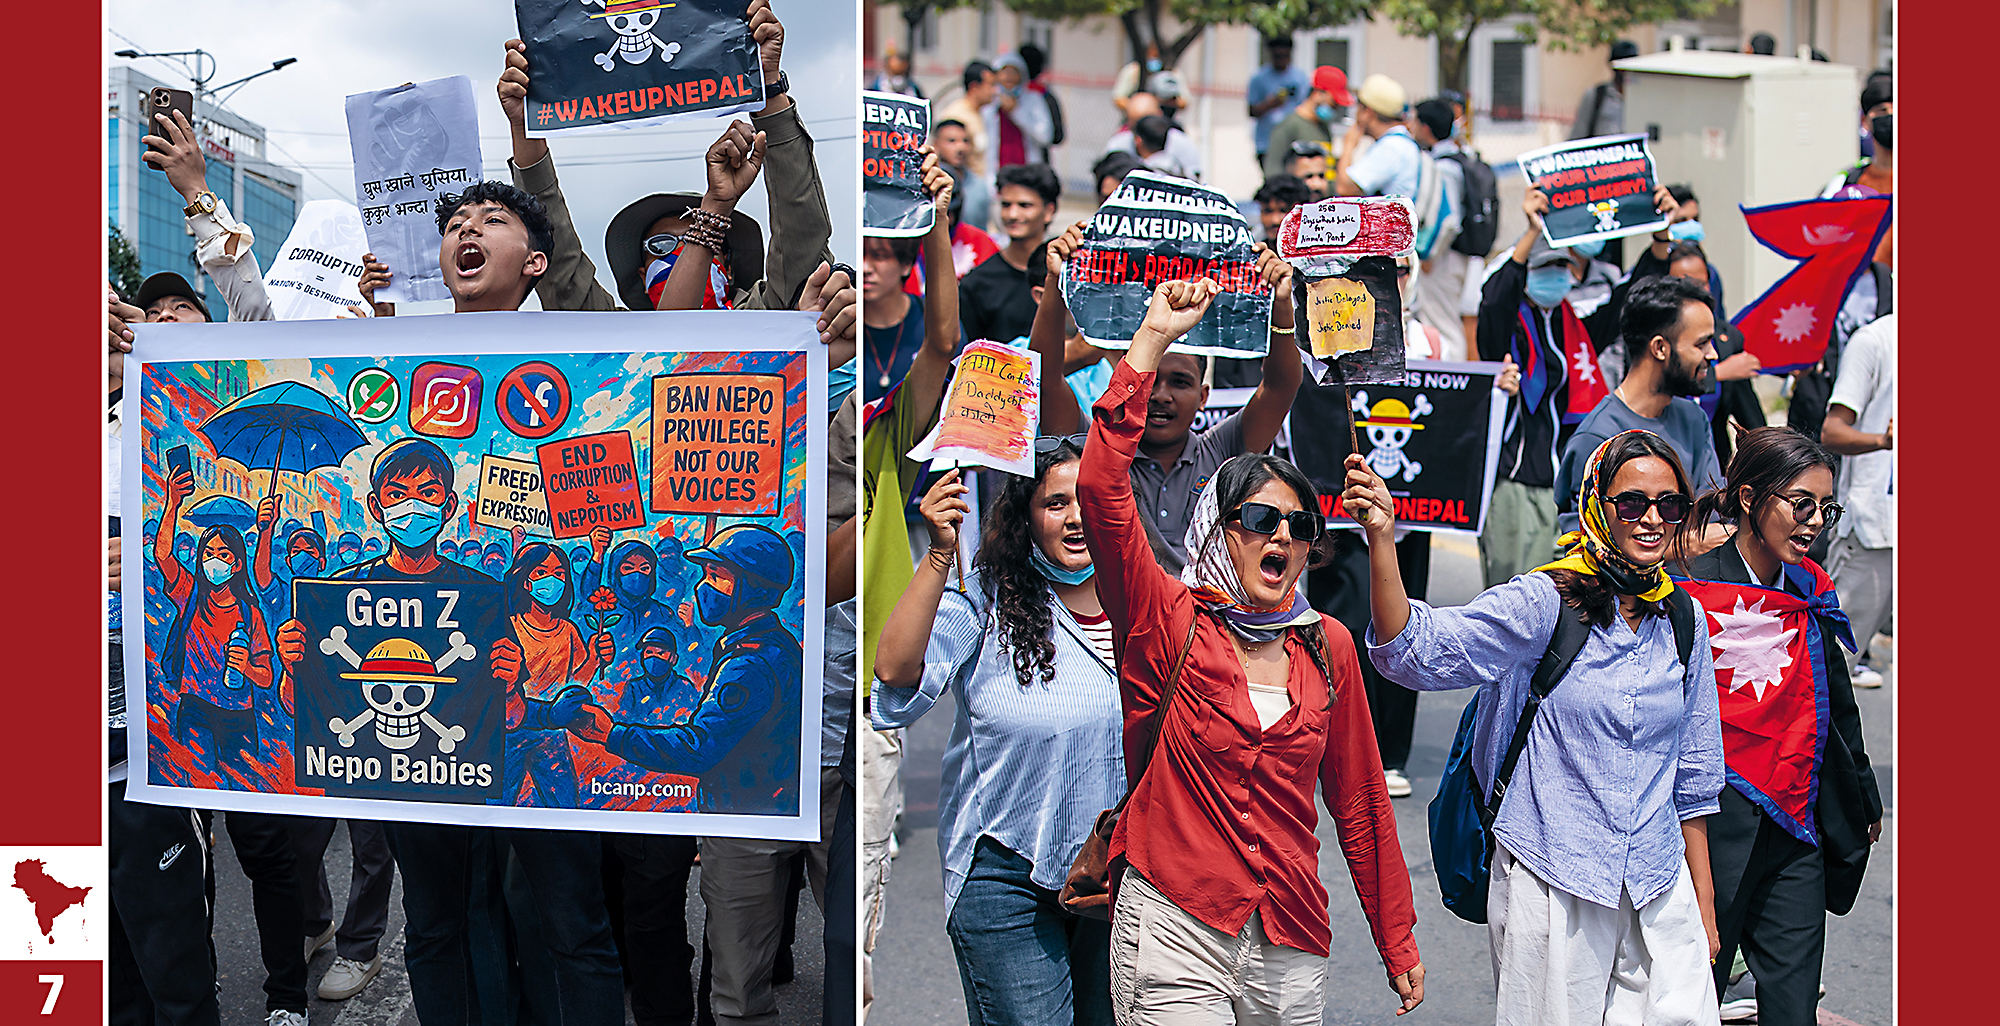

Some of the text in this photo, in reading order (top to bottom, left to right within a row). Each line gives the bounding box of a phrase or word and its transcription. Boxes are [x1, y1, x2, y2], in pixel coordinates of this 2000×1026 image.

[537, 75, 752, 125] #WAKEUPNEPAL
[863, 103, 923, 129] EPAL
[1529, 143, 1645, 176] #WAKEUPNEPAL
[363, 181, 383, 200] घुस
[385, 173, 415, 191] खाने
[1540, 170, 1587, 190] YOUR
[363, 205, 391, 225] कुकुर
[395, 200, 428, 215] भन्दा
[1552, 189, 1587, 209] OUR
[289, 248, 363, 277] CORRUPTIO
[1072, 250, 1129, 285] TRUTH
[268, 279, 362, 307] NATION'S DESTRUCTION!
[1424, 373, 1470, 391] NOW
[666, 385, 773, 415] BAN NEPO
[664, 419, 776, 447] PRIVILEGE,
[561, 443, 607, 468] END
[674, 449, 759, 474] NOT OUR
[488, 465, 544, 493] FREED
[550, 462, 632, 493] CORRUPTION
[669, 476, 756, 502] VOICES
[509, 491, 528, 503] OF
[586, 489, 600, 503] &
[557, 500, 637, 530] NEPOTISM
[346, 588, 460, 628] Gen Z
[306, 745, 492, 787] Nepo Babies
[591, 778, 692, 801] bcanp.com
[163, 842, 180, 860] NIKE
